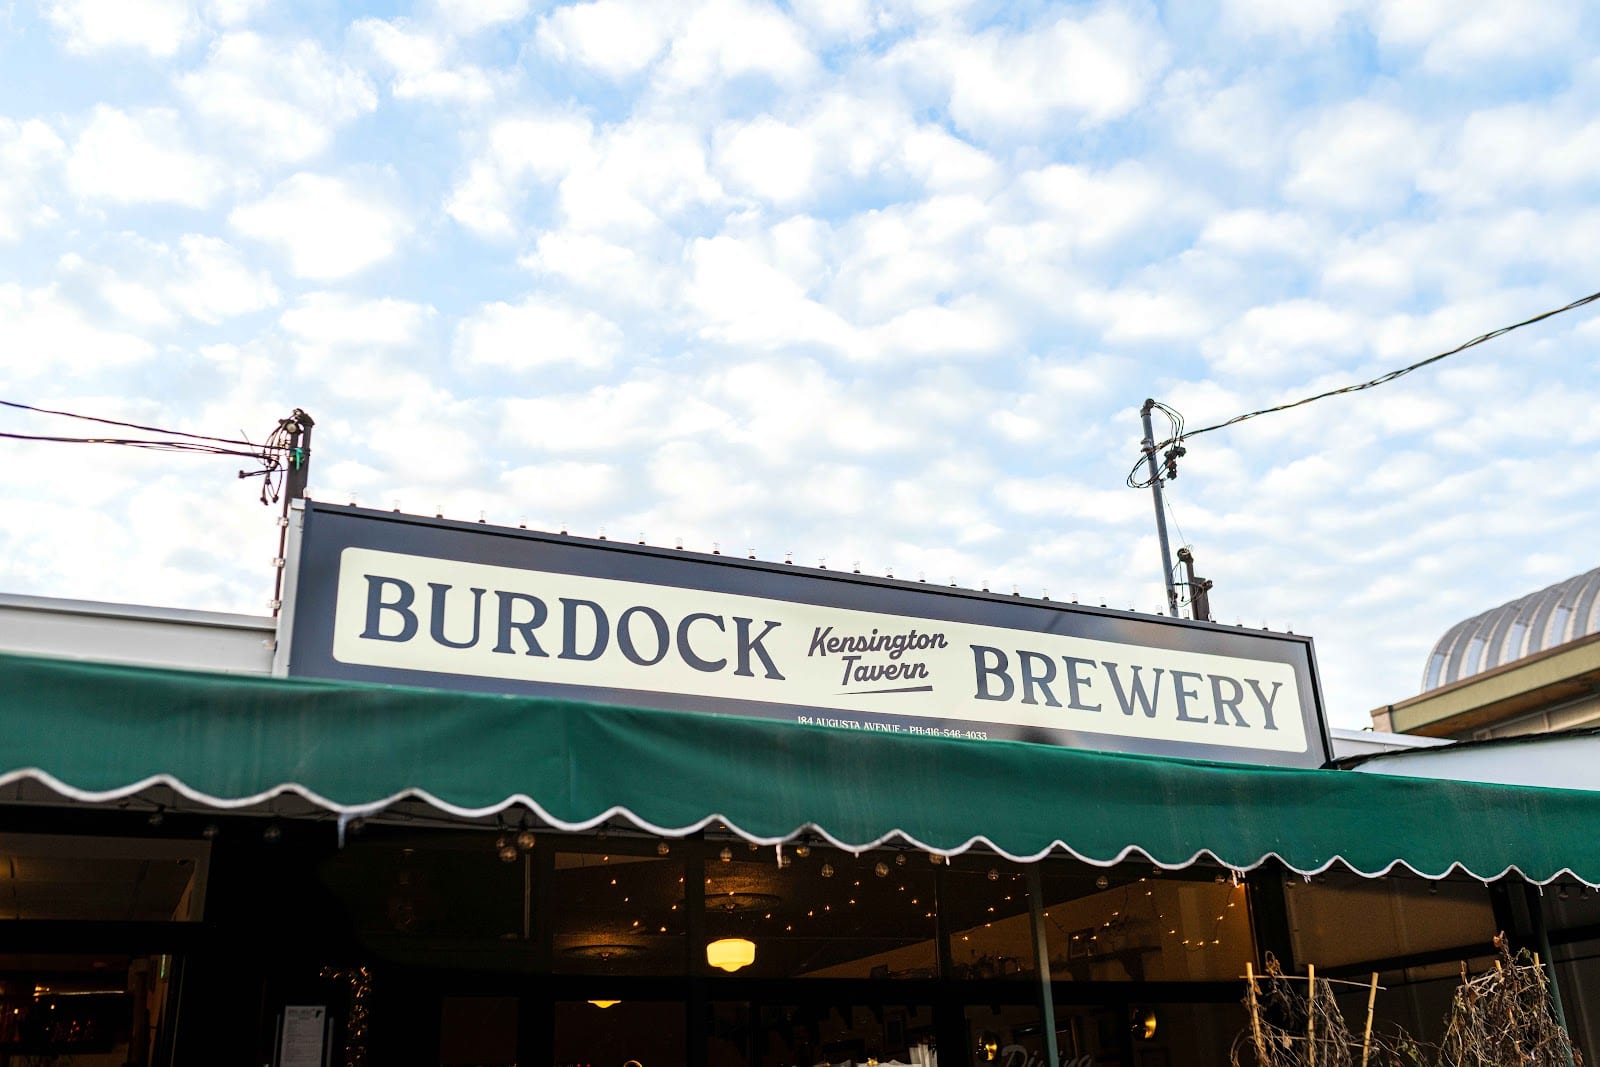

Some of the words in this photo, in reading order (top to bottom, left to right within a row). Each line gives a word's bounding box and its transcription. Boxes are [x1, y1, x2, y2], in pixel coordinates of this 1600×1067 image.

[359, 575, 785, 680] BURDOCK
[970, 645, 1283, 730] BREWERY
[807, 626, 949, 660] Kensington
[841, 655, 929, 686] Tavern
[797, 716, 813, 726] 184
[816, 717, 861, 731] AUGUSTA
[863, 721, 900, 733] AVENUE
